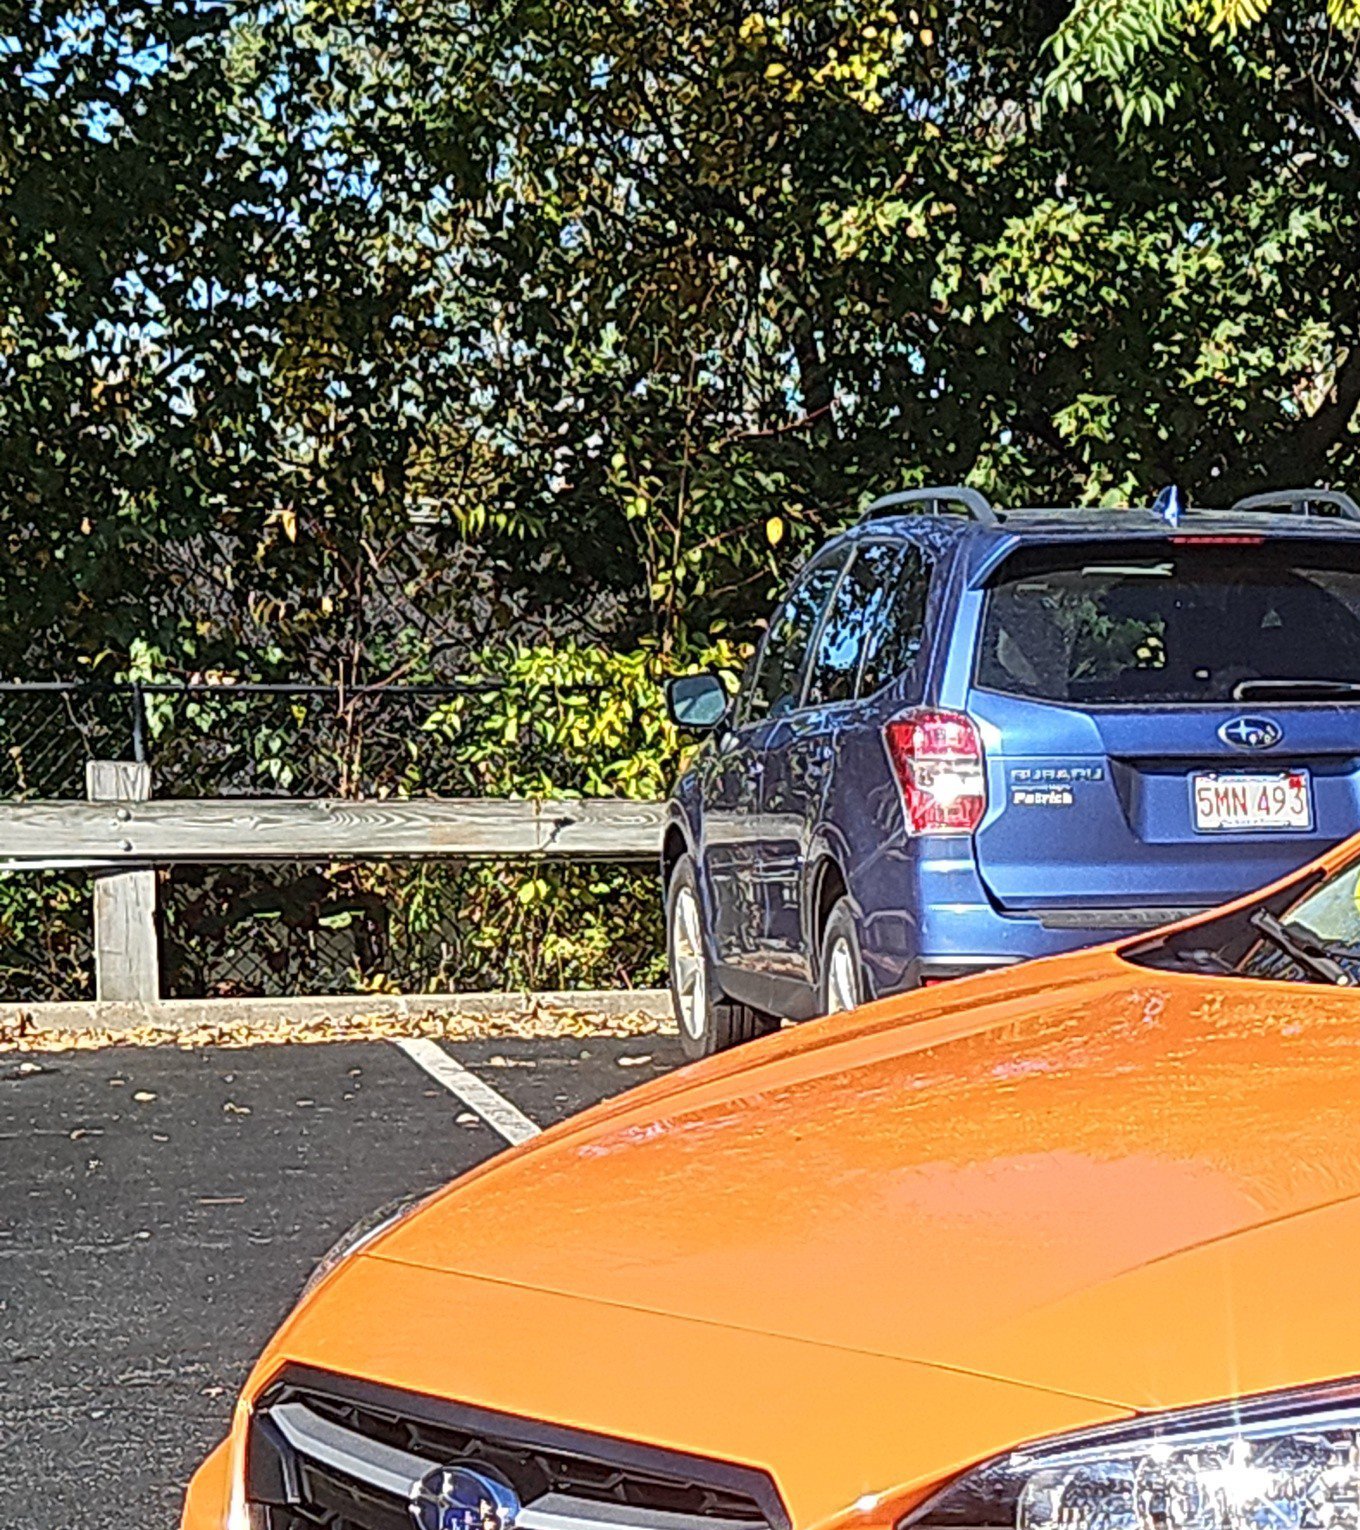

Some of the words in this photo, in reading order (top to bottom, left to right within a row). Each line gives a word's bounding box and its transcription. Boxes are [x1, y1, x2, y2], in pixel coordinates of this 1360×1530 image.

[1011, 767, 1103, 780] SUBARU
[1197, 786, 1248, 817] 5MN
[1257, 785, 1305, 816] 493
